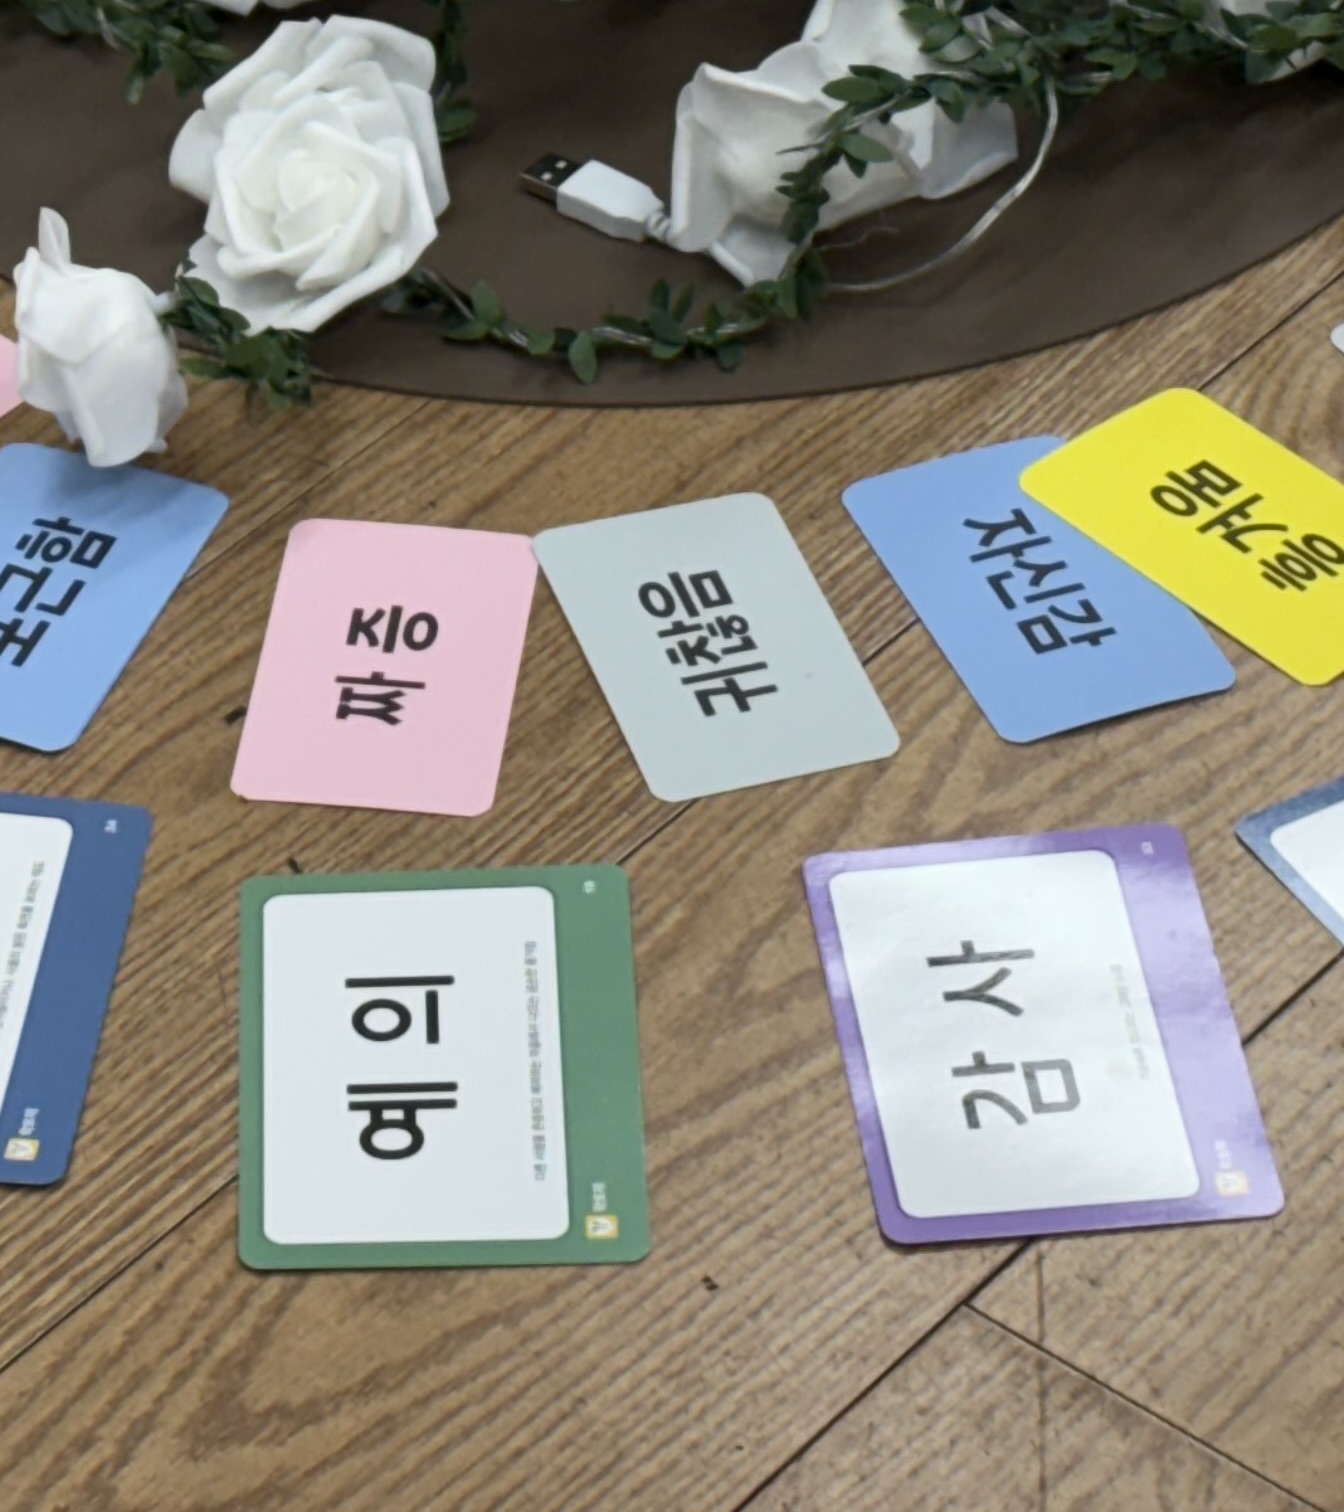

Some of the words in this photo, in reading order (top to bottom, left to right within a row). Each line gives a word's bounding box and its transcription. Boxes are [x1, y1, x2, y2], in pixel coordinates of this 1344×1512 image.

[637, 569, 778, 718] 귀찮음
[964, 509, 1115, 655] 자신감
[335, 605, 440, 726] 짜증
